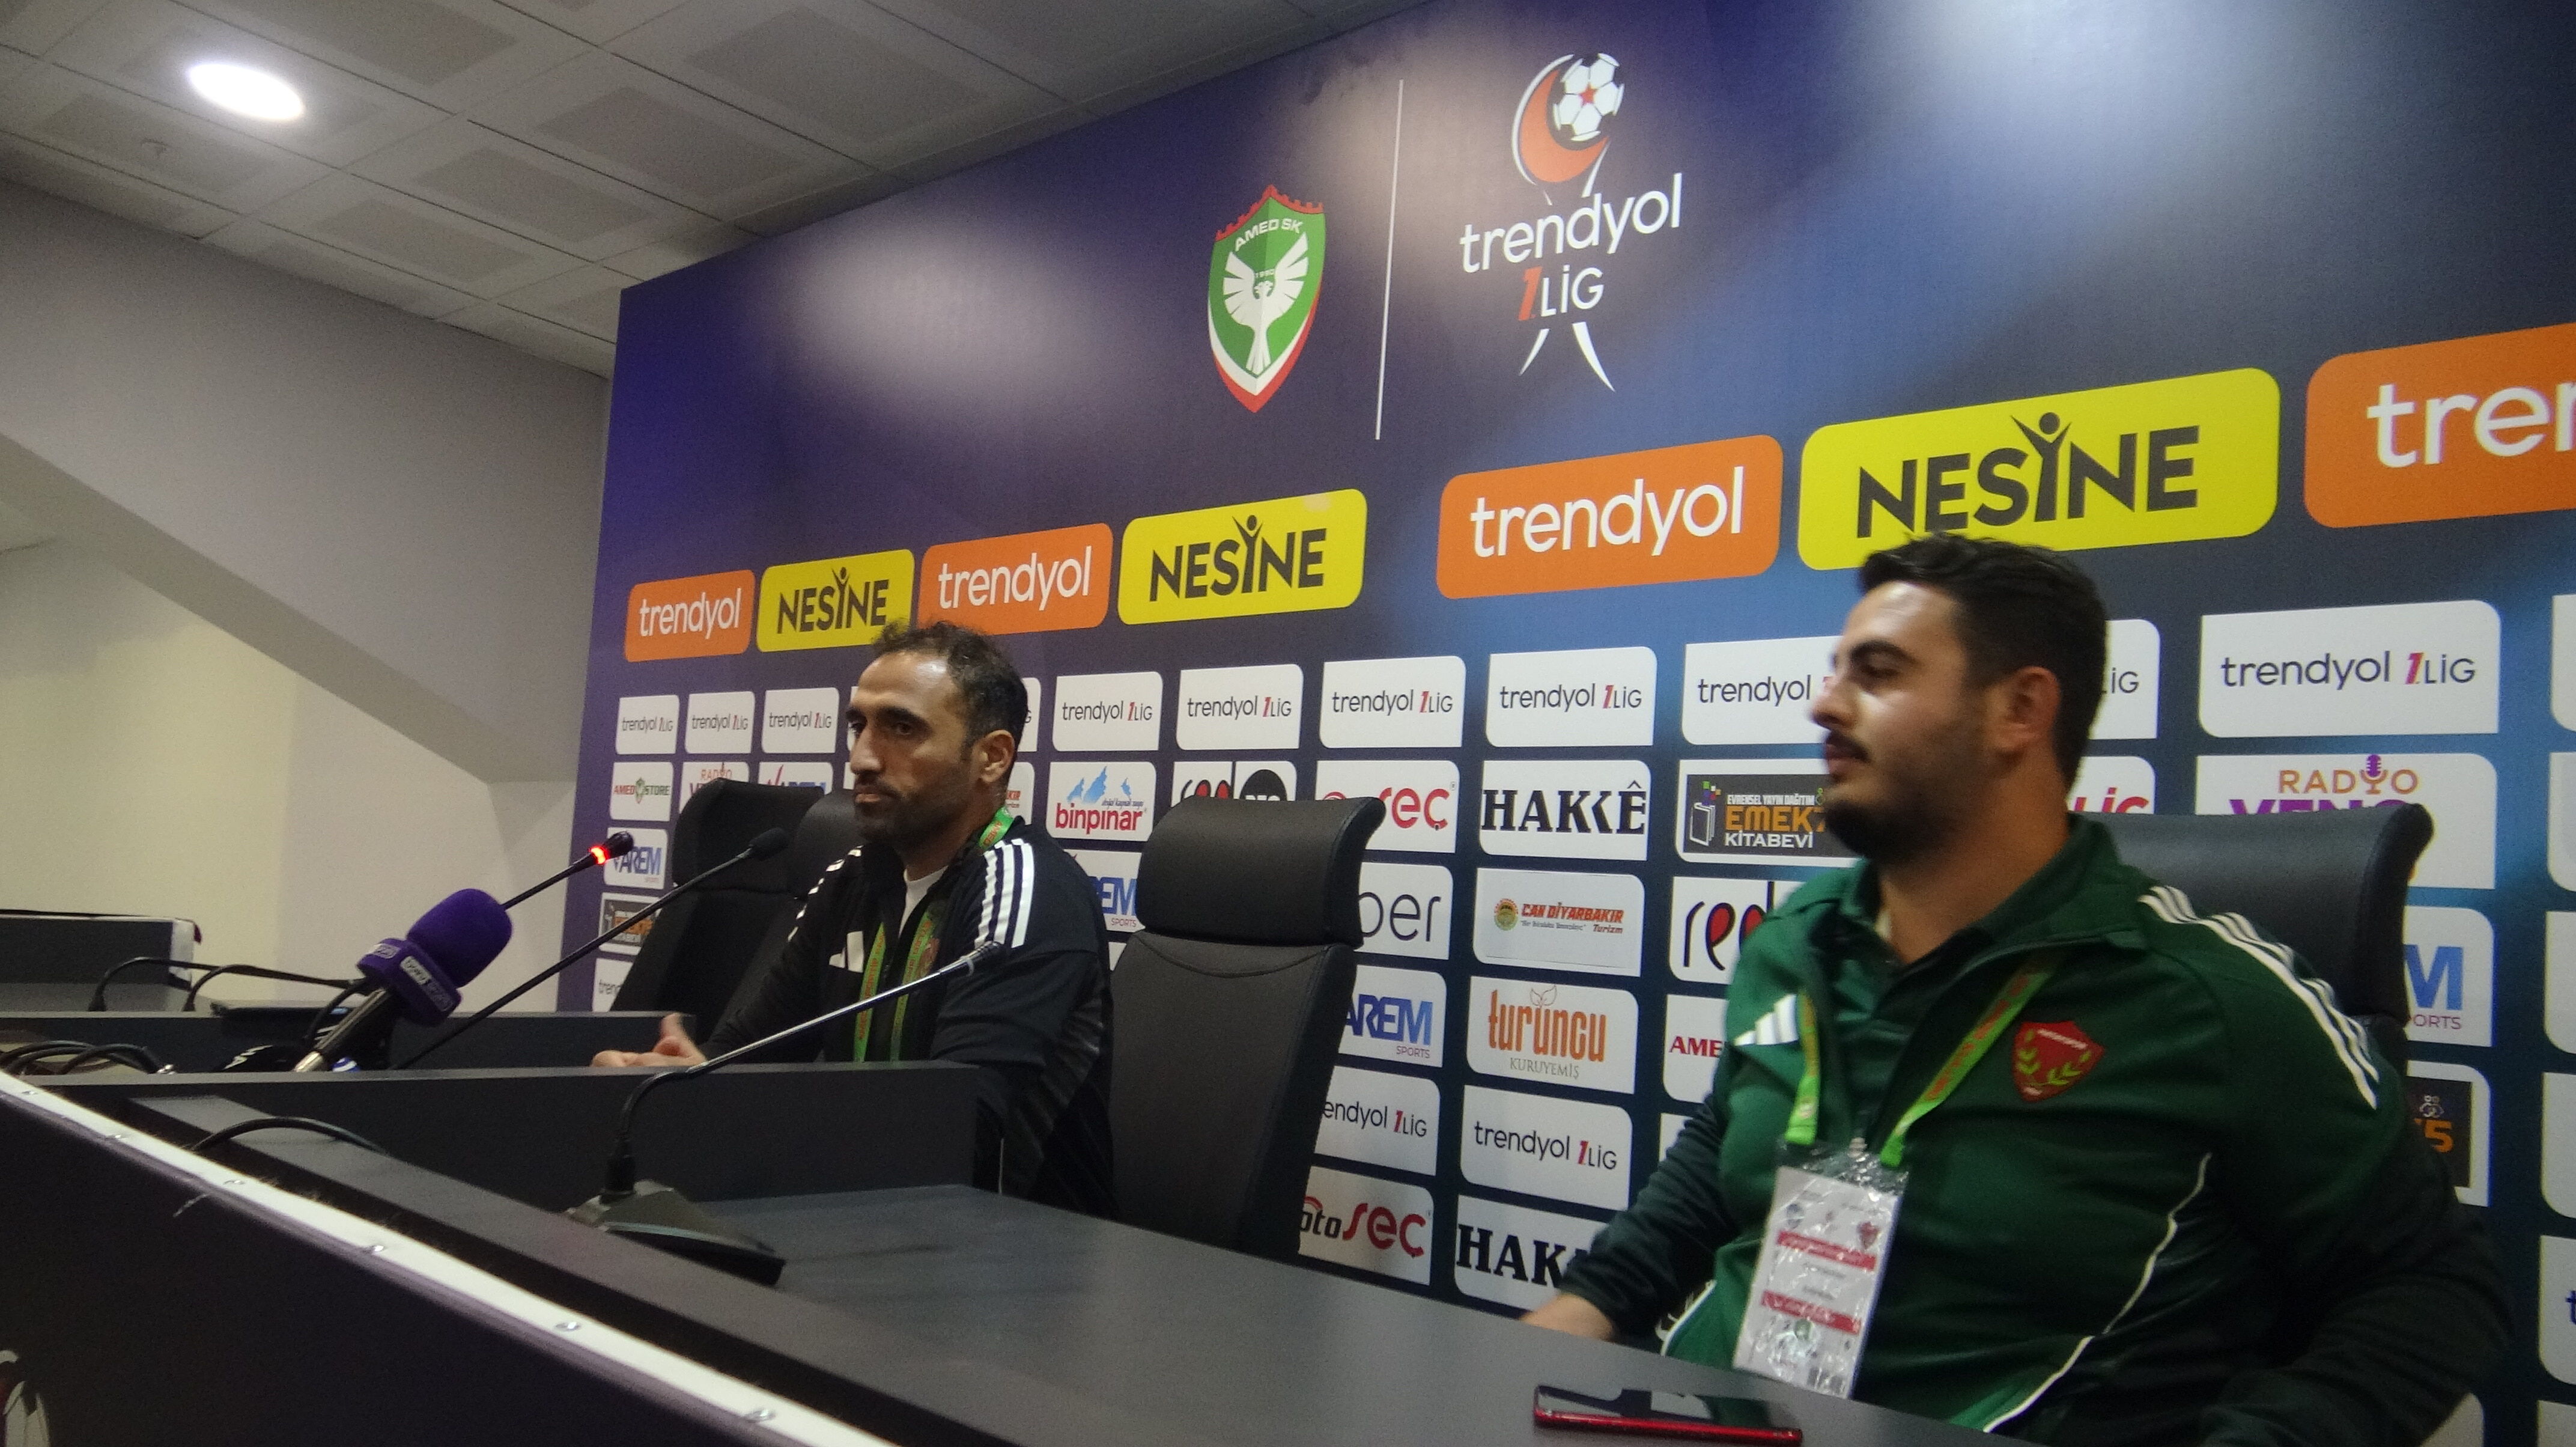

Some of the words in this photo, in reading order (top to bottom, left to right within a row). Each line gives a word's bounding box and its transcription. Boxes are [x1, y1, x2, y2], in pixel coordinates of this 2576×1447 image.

[1235, 219, 1280, 251] AMED
[1281, 218, 1303, 234] SK
[1460, 172, 1682, 273] trendyol
[1470, 466, 1743, 556] trendyol
[938, 546, 1092, 611] trendyol
[640, 587, 741, 639] trendyol
[2221, 650, 2390, 690] trendyol
[1332, 689, 1414, 716] trendyol
[1500, 683, 1595, 713] trendyol
[1698, 674, 1811, 707] trendyol
[770, 711, 812, 731] trendyol
[1062, 701, 1123, 724] trendyol
[1188, 695, 1258, 720] trendyol
[621, 716, 657, 734] trendyol
[692, 714, 731, 732] trendyol
[2278, 768, 2419, 794] RADYO
[1489, 989, 1607, 1062] turuncu
[1396, 1046, 1430, 1059] SPORTS
[1323, 1101, 1388, 1130] endyol
[1474, 1121, 1570, 1162] trendyol
